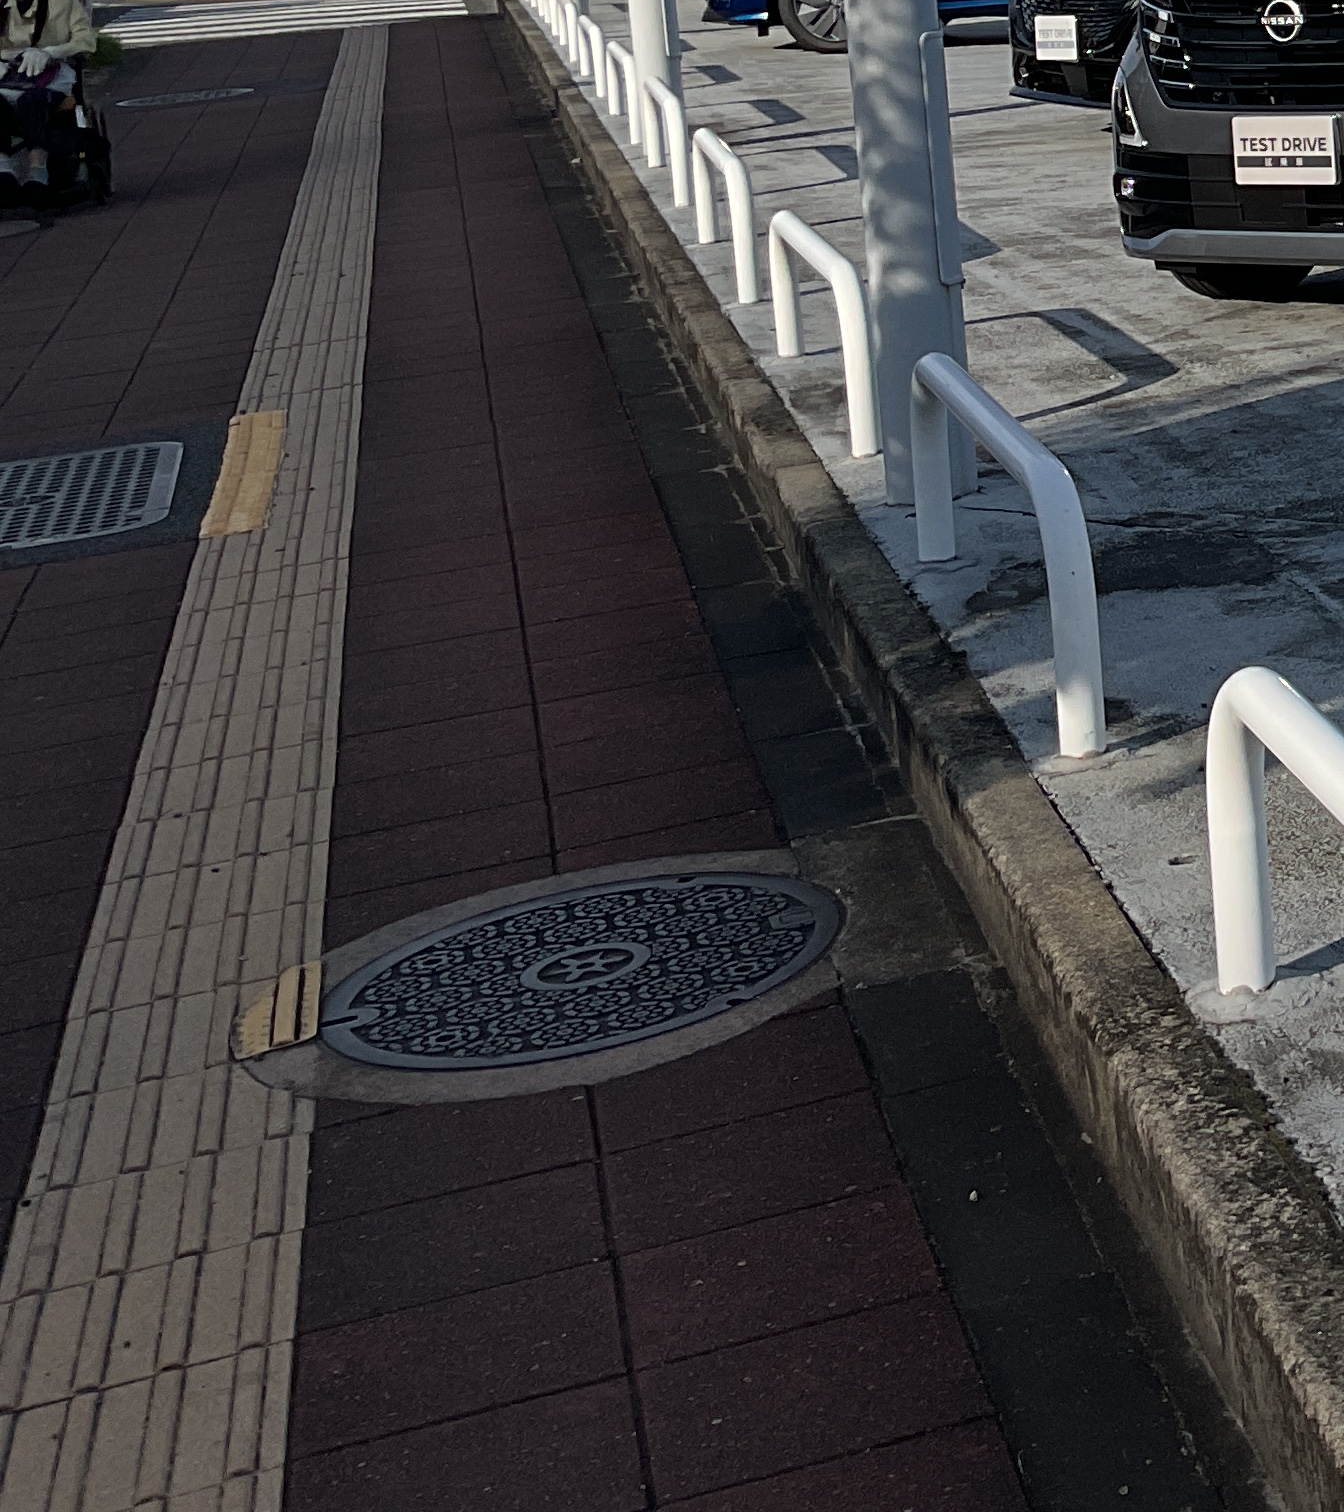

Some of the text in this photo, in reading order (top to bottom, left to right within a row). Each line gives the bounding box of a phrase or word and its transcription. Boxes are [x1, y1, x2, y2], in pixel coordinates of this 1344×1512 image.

[1260, 15, 1304, 25] NISSAN
[1240, 137, 1327, 152] TEST DRIVE
